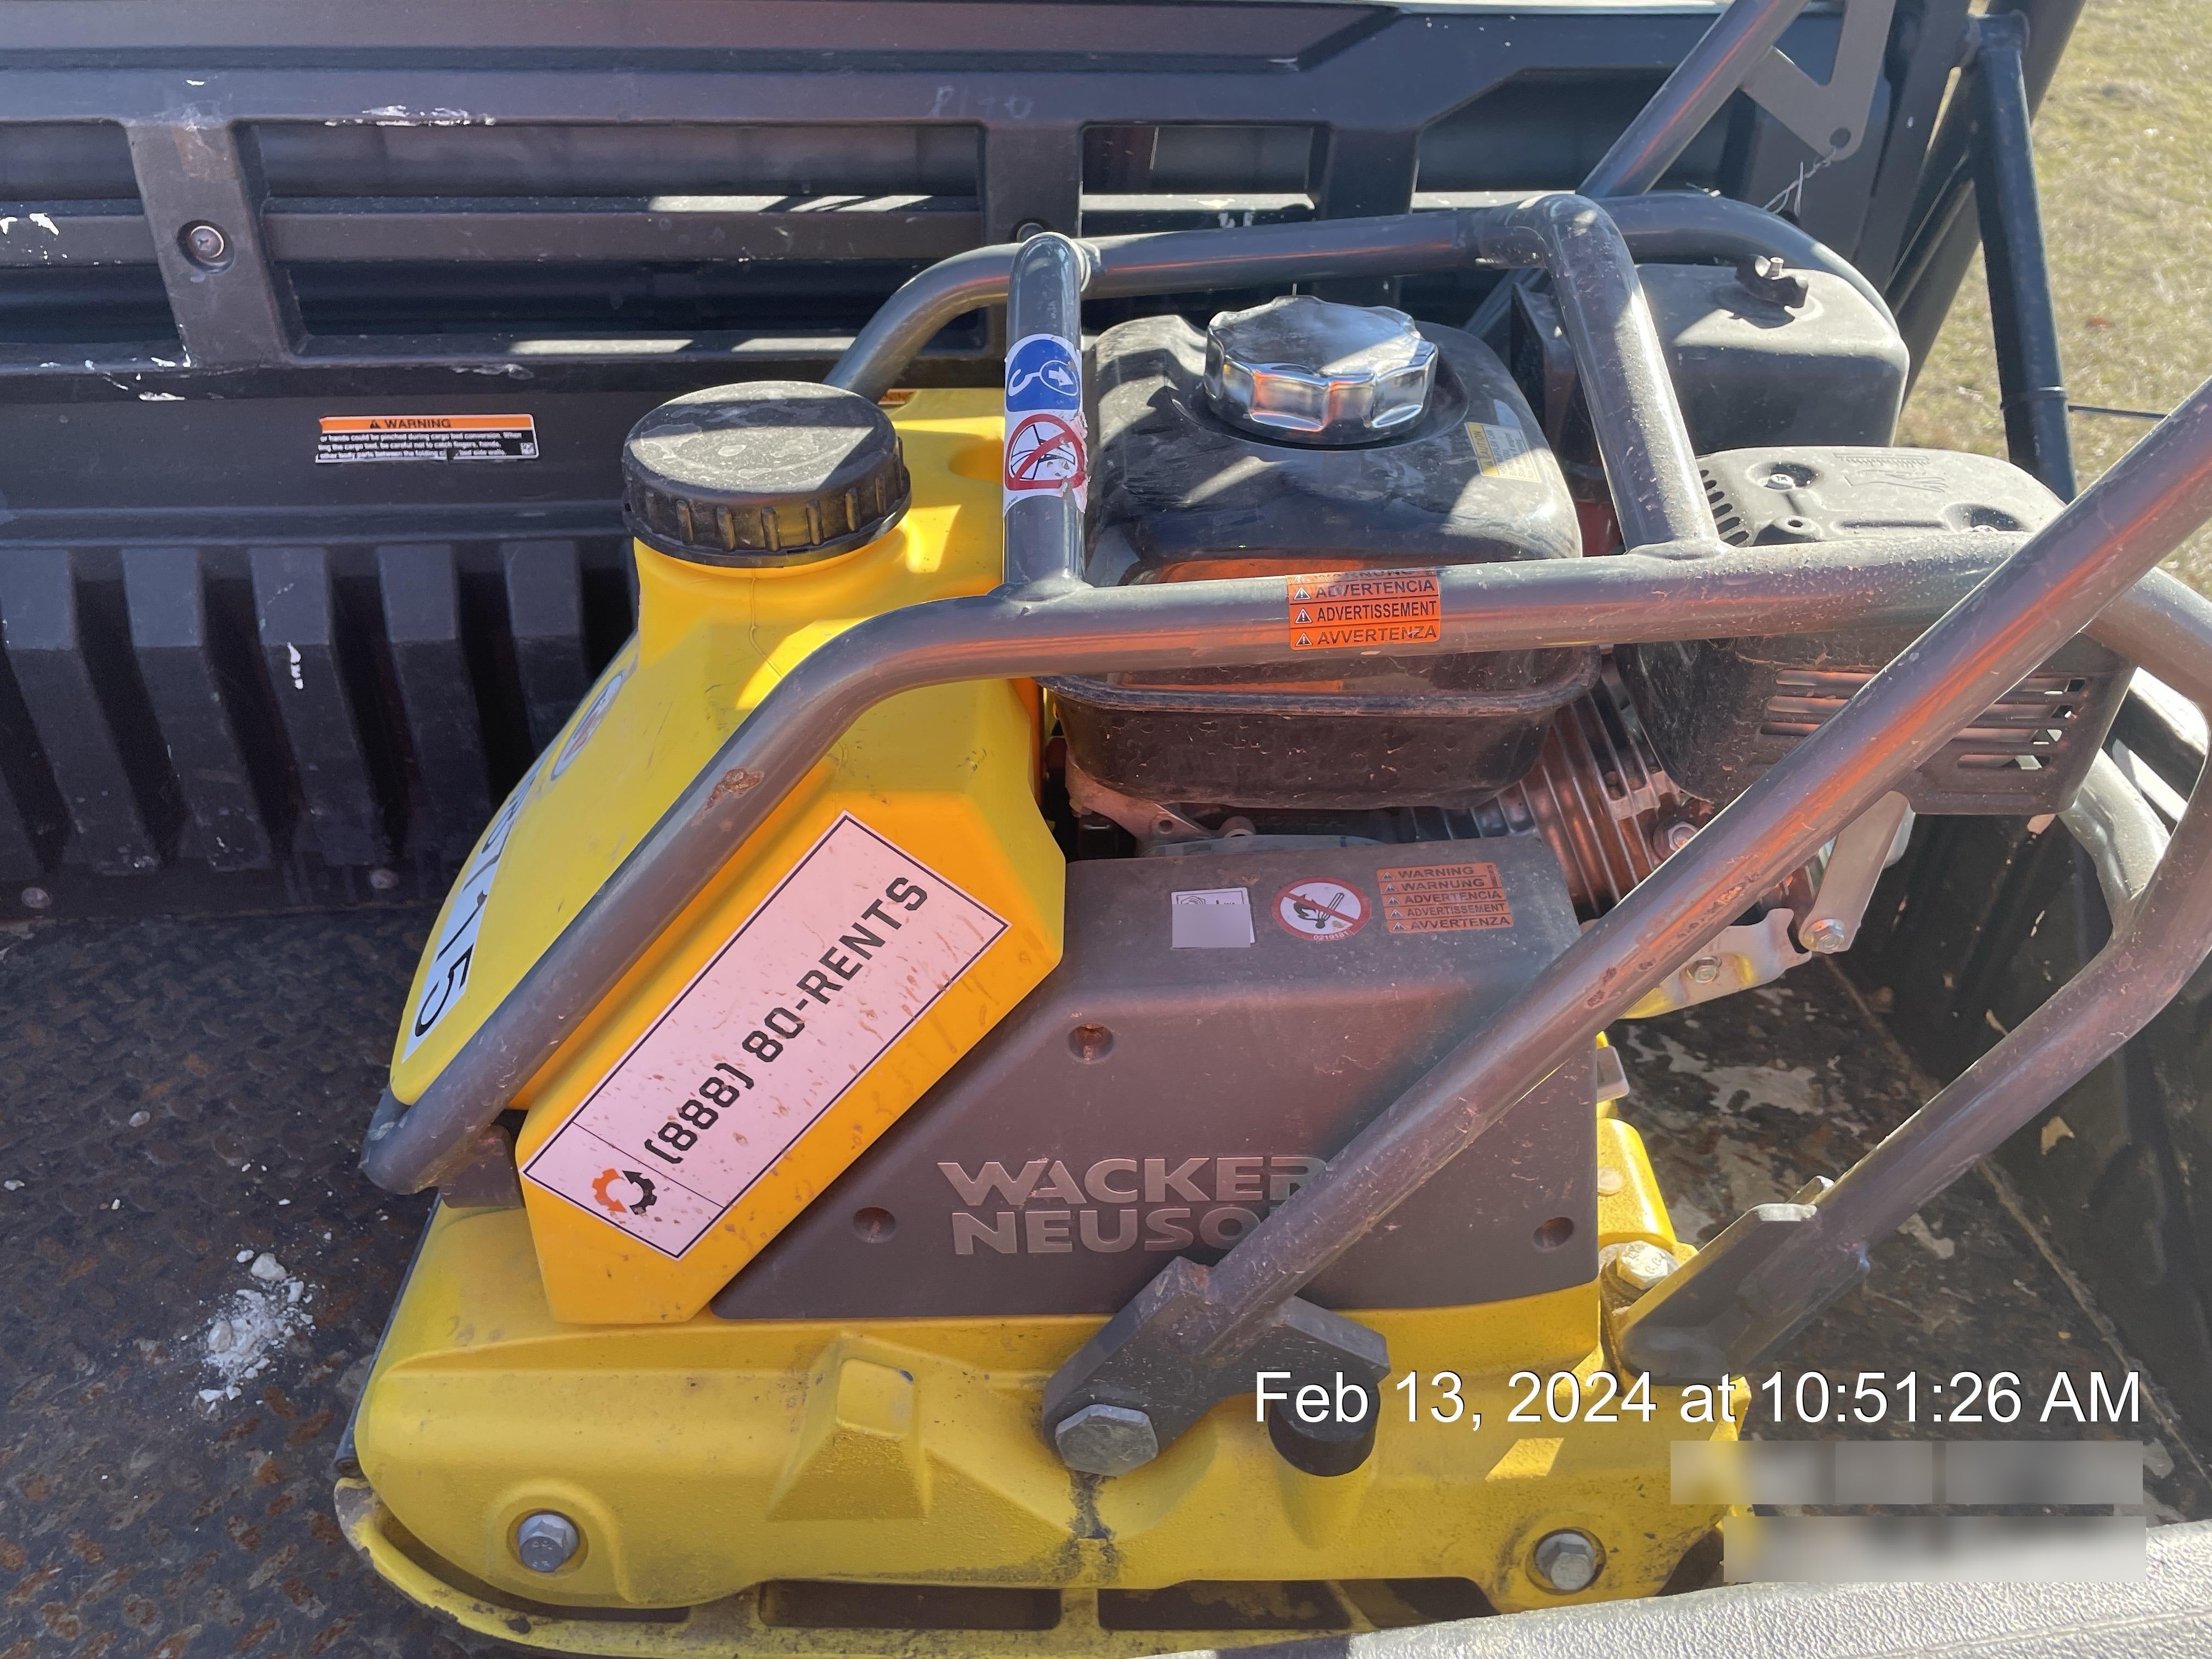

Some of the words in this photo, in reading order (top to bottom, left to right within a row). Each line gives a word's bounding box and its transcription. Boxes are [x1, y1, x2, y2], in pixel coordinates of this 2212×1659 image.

[385, 418, 451, 429] WARNING
[1316, 579, 1435, 599] ADVERTENCIA
[1317, 601, 1436, 623] ADVERTISSEMENT
[1317, 624, 1437, 645] AVVERTENZA
[1398, 866, 1474, 878] WARNING
[1401, 878, 1485, 891] WARNUNG
[1404, 890, 1502, 904] ADVERTENCIA
[1407, 903, 1505, 917] ADVERTISSEMENT
[1410, 916, 1511, 930] AVVERTENZA
[644, 1062, 755, 1165] (888)
[741, 877, 928, 1063] 80-RENTS
[937, 1156, 1327, 1206] WACKER
[951, 1207, 1273, 1255] NEUSO
